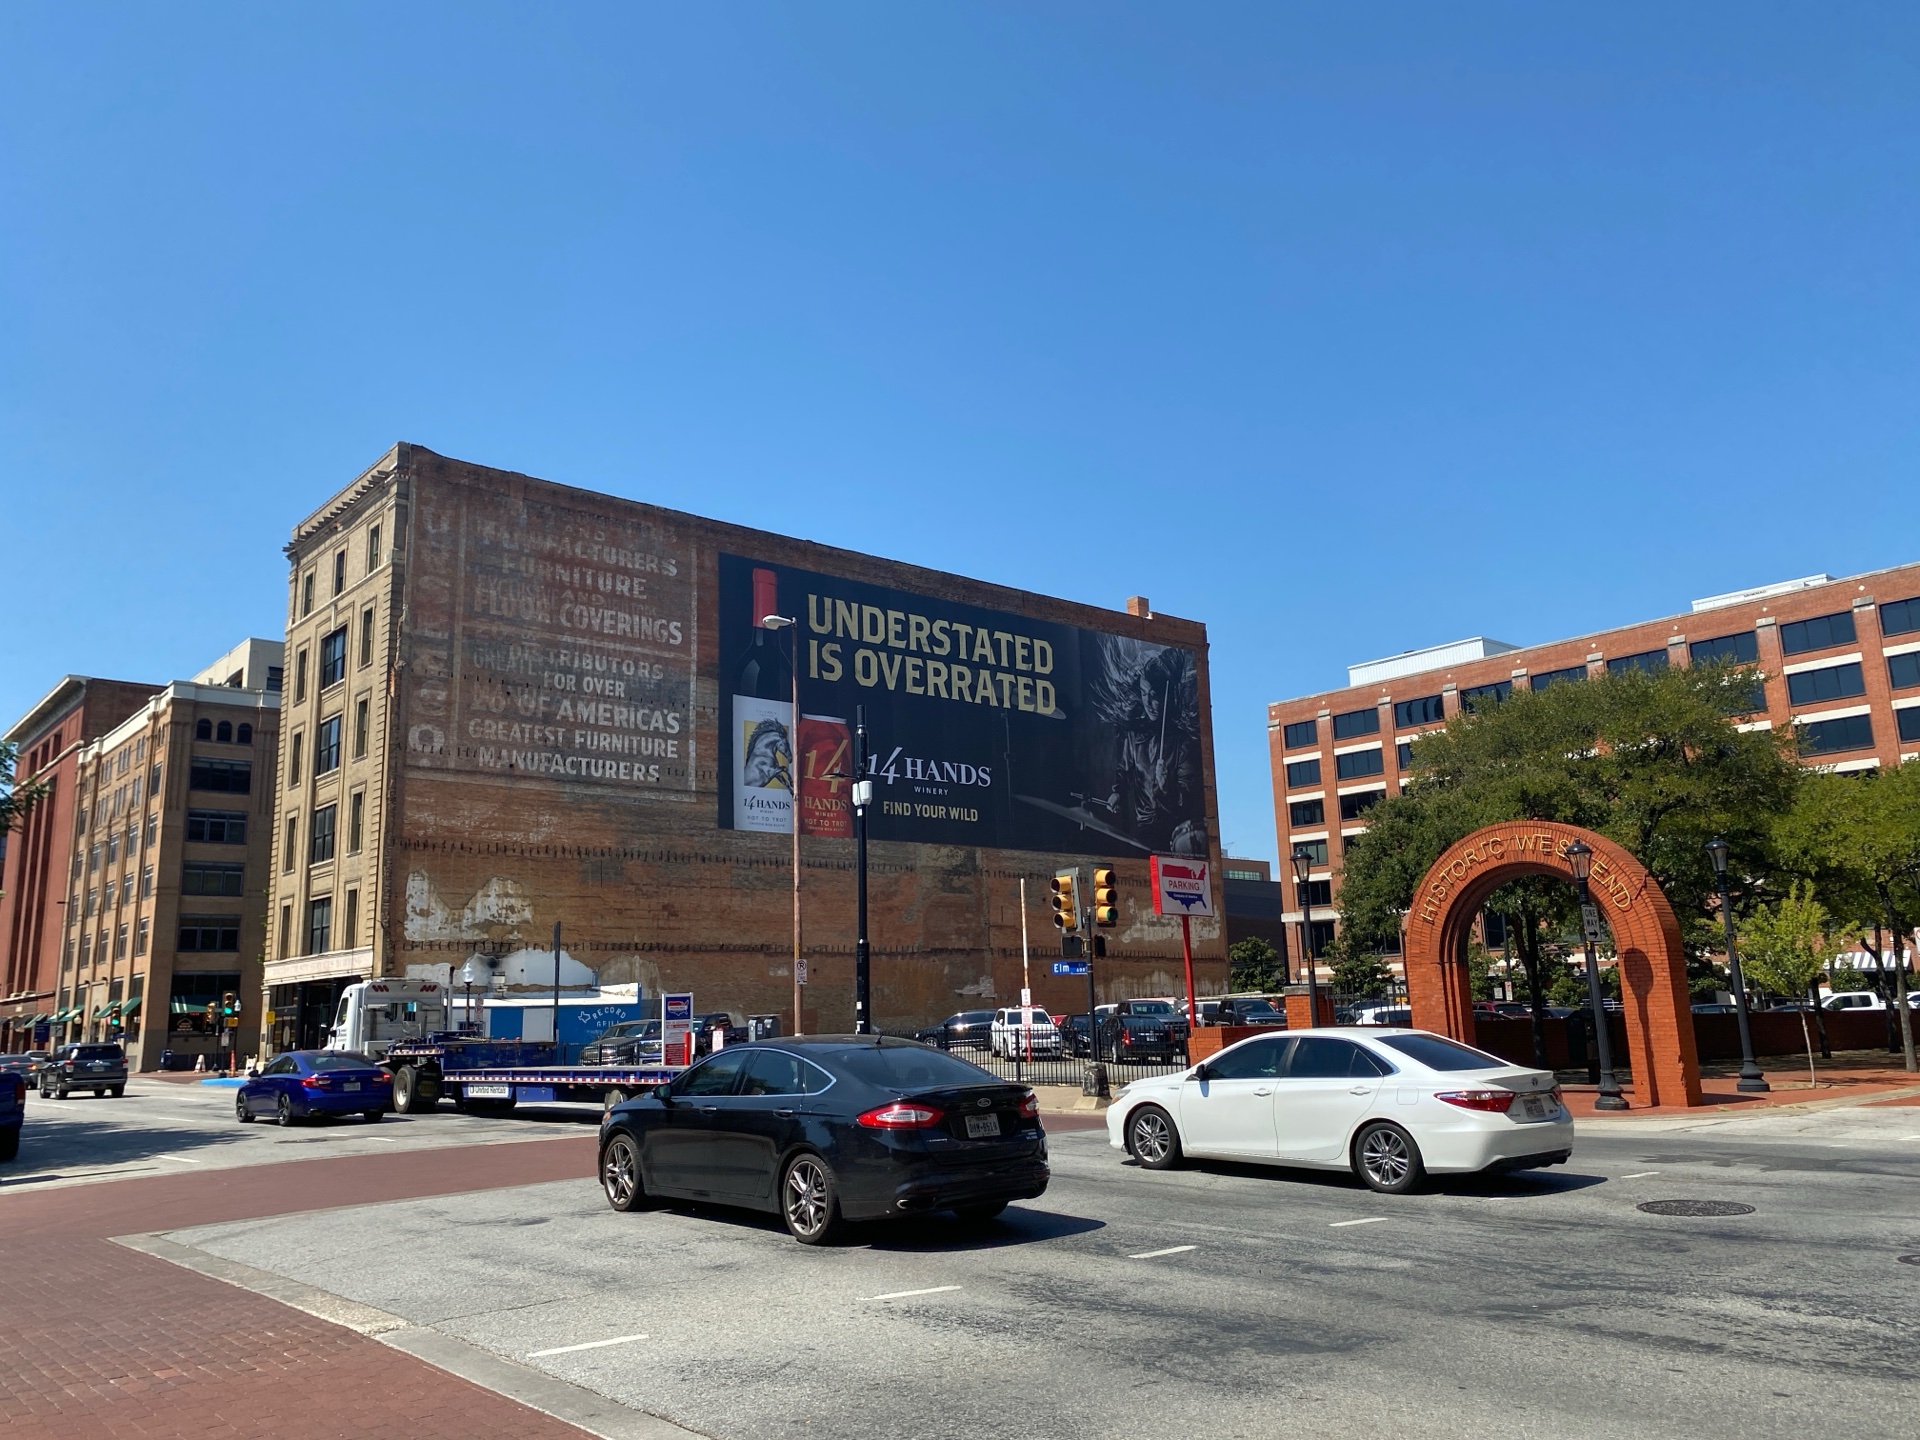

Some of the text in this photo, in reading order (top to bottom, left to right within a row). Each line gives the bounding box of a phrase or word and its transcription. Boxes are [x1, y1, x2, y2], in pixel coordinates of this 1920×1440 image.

[502, 553, 648, 600] FURNITURE
[559, 602, 683, 645] COVERINGS
[808, 593, 1054, 676] UNDERSTATED
[544, 671, 625, 698] FOR OVER
[808, 639, 1057, 715] IS OVERRATED
[556, 698, 681, 734] AMERICA'S
[468, 718, 679, 759] GREATEST FURNITURE
[478, 746, 660, 783] MANUFACTURERS
[804, 738, 849, 811] 14 HANDS
[867, 746, 991, 787] 14 HANDS
[743, 795, 791, 811] 14 HANDS
[913, 786, 949, 796] WINERY
[804, 818, 818, 826] HOT
[820, 819, 830, 827] TO
[883, 800, 979, 822] FIND YOUR WILD
[1168, 879, 1200, 891] PARKING
[1420, 837, 1502, 922] HISTORIC
[1590, 861, 1631, 908] END
[1584, 908, 1597, 918] ONE
[1586, 919, 1598, 928] WAY
[1053, 963, 1070, 973] Elm
[592, 1006, 627, 1020] RECORD
